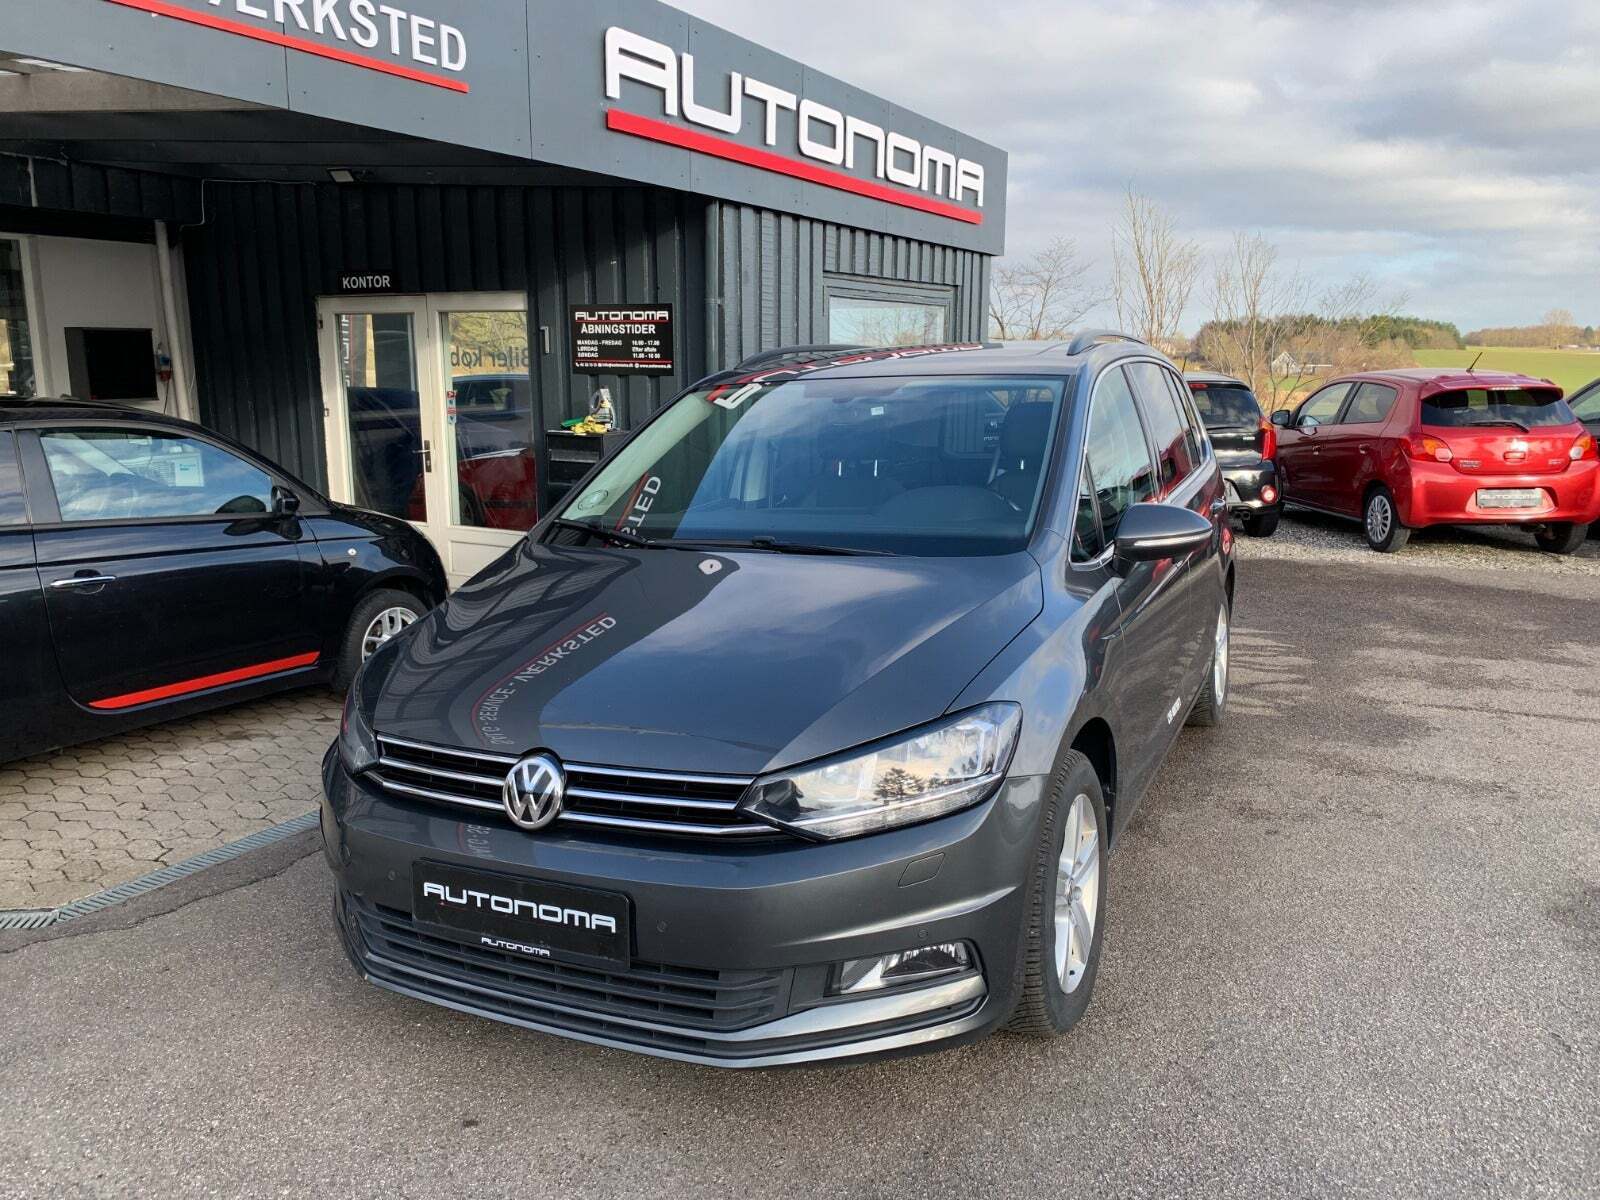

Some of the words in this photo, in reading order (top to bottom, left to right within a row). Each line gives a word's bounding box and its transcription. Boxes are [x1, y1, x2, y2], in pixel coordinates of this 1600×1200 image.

[604, 26, 984, 207] AUTONOMA
[342, 275, 391, 289] KONTOR
[574, 311, 669, 321] AUTONOMA
[581, 322, 656, 334] ÅBNINGSTIDER
[423, 881, 616, 934] AUTONOMA
[481, 936, 550, 957] AUTONOMA
